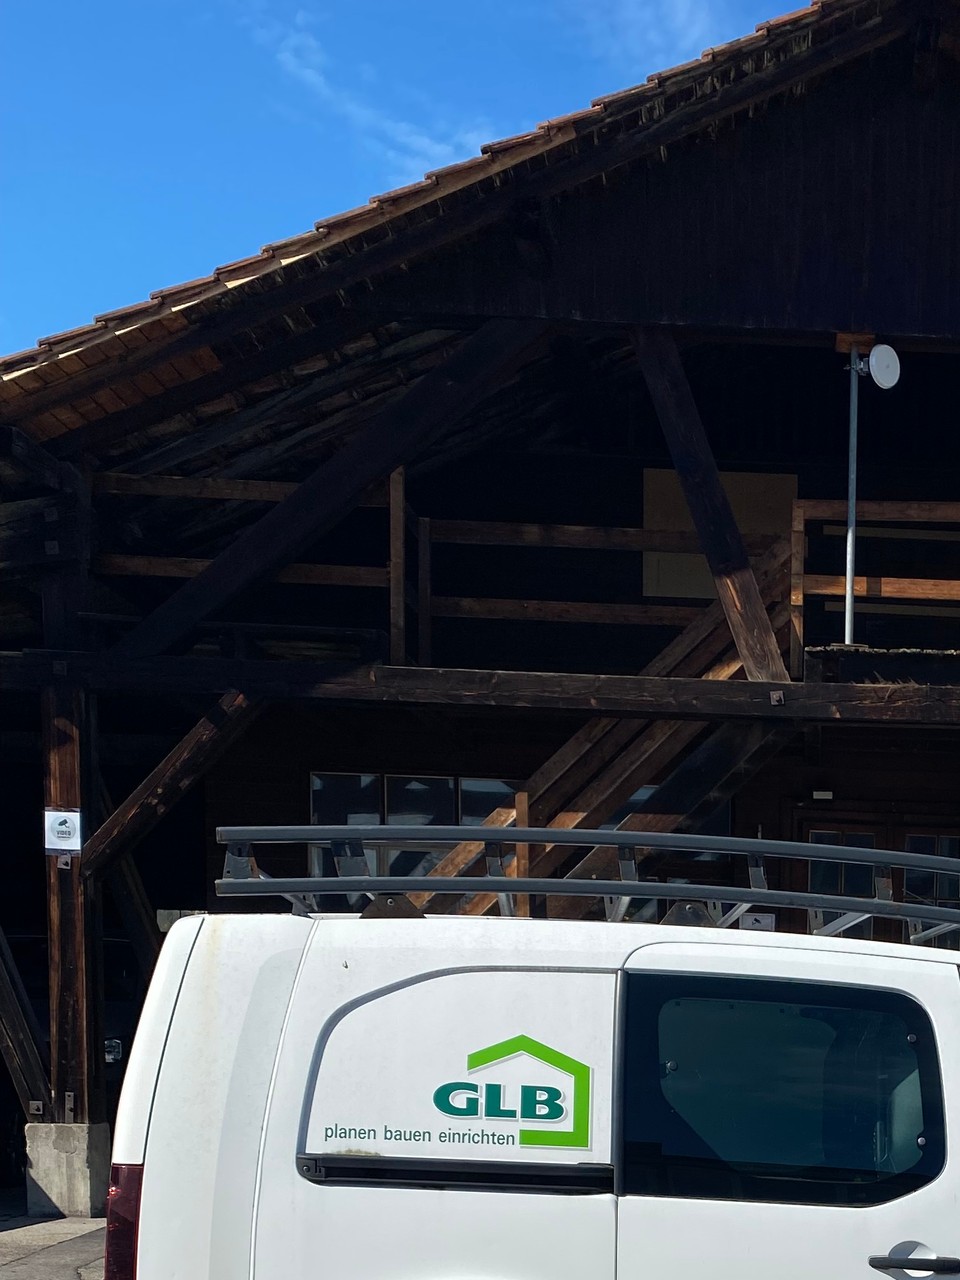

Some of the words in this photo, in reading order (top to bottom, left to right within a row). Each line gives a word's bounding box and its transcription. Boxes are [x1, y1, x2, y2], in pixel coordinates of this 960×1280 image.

[433, 1081, 565, 1120] GLB
[324, 1124, 377, 1142] planen
[383, 1125, 432, 1142] bauen
[438, 1128, 515, 1146] einrichten
